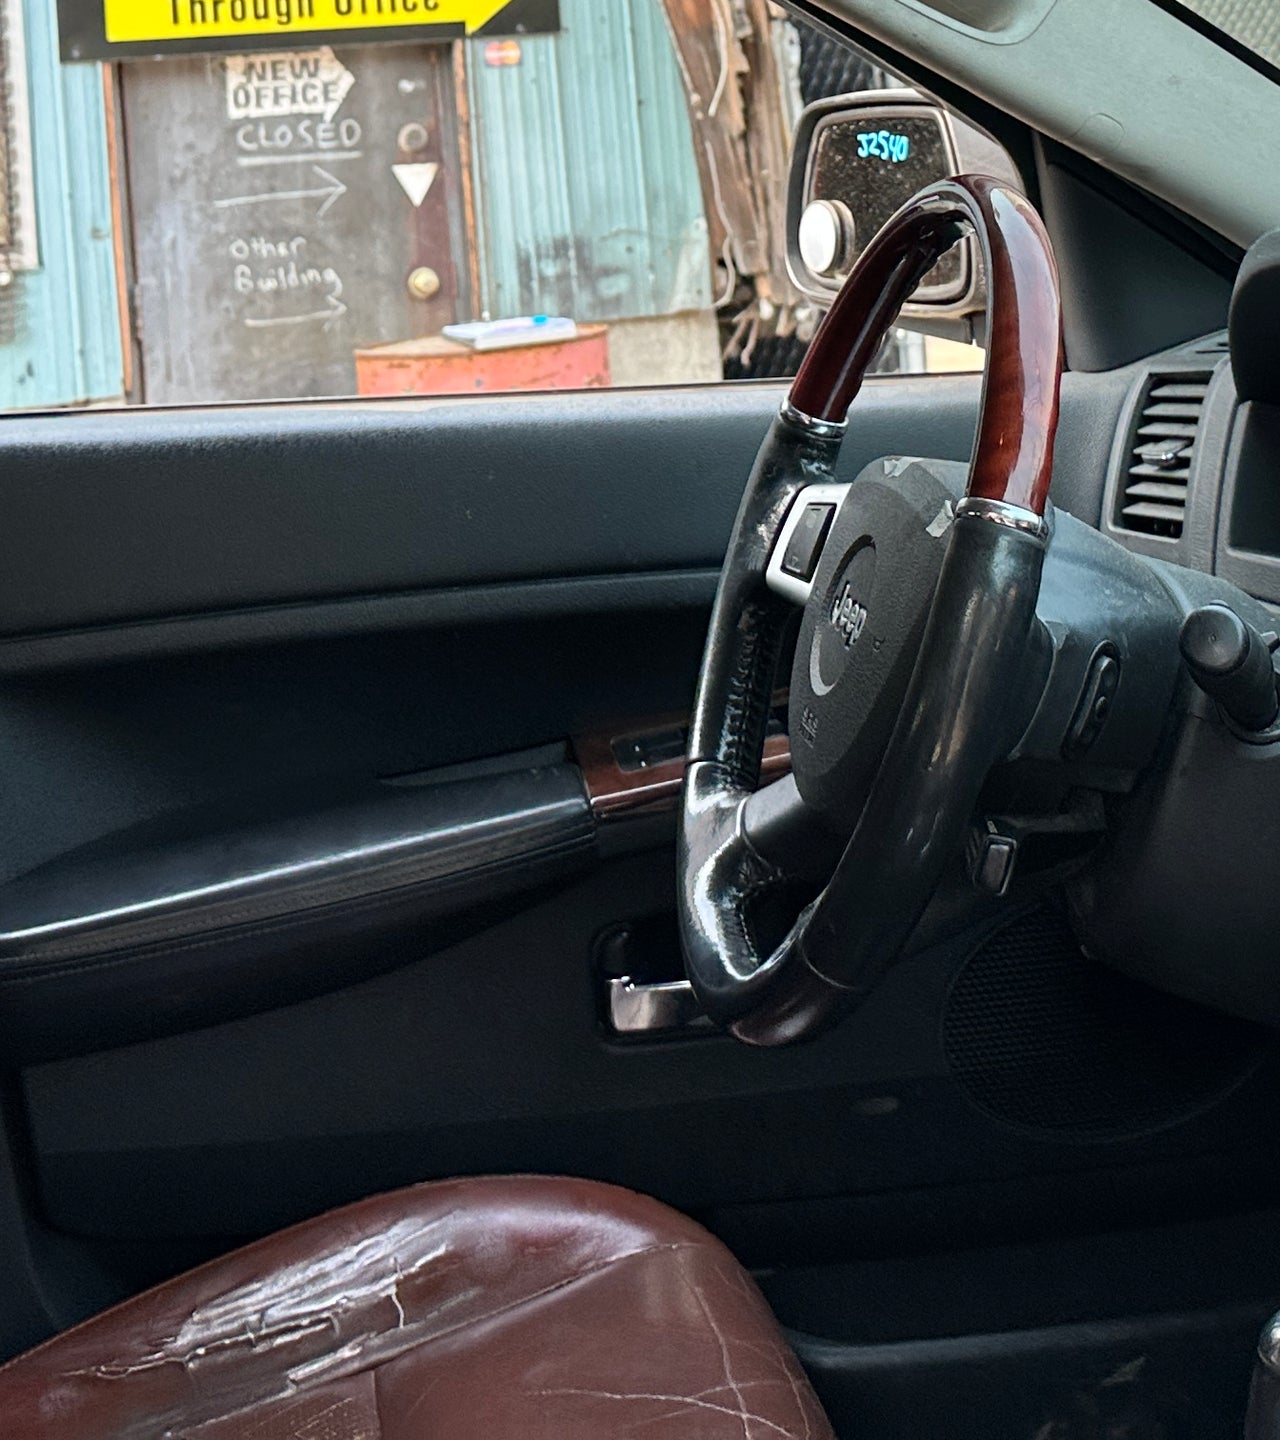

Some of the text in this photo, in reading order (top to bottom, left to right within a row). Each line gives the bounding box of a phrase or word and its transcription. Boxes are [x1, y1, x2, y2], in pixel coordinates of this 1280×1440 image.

[244, 57, 320, 82] NEW
[232, 81, 340, 109] OFFICE
[236, 117, 362, 152] CLOSED
[831, 581, 867, 650] Jeep
